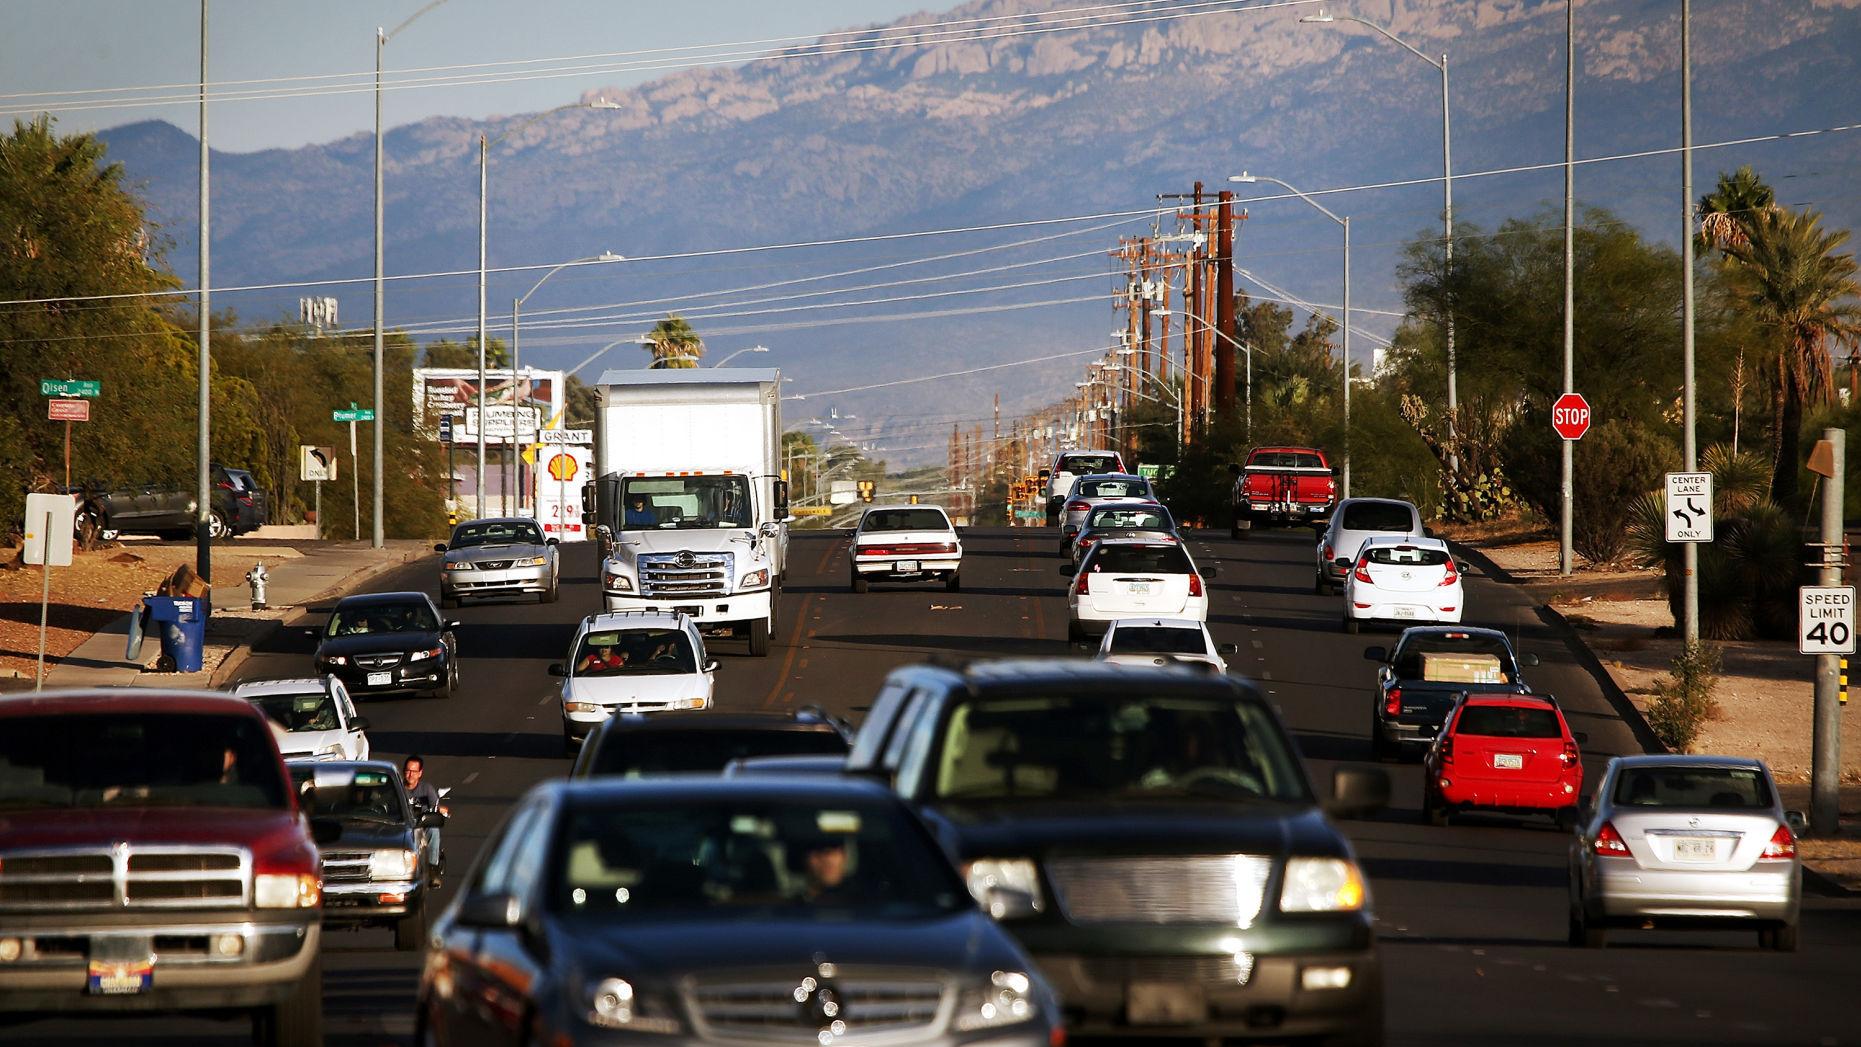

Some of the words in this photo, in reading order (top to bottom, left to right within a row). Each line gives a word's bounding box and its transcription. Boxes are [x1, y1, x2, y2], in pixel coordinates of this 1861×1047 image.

[42, 382, 68, 394] Olsen
[1555, 407, 1588, 425] STOP
[544, 432, 588, 441] GRANT
[1672, 476, 1706, 484] CENTER
[1677, 485, 1701, 493] LANE
[1677, 530, 1702, 538] ONLY
[1805, 594, 1850, 605] SPEED
[1810, 607, 1845, 618] LIMIT
[1806, 621, 1850, 646] 40
